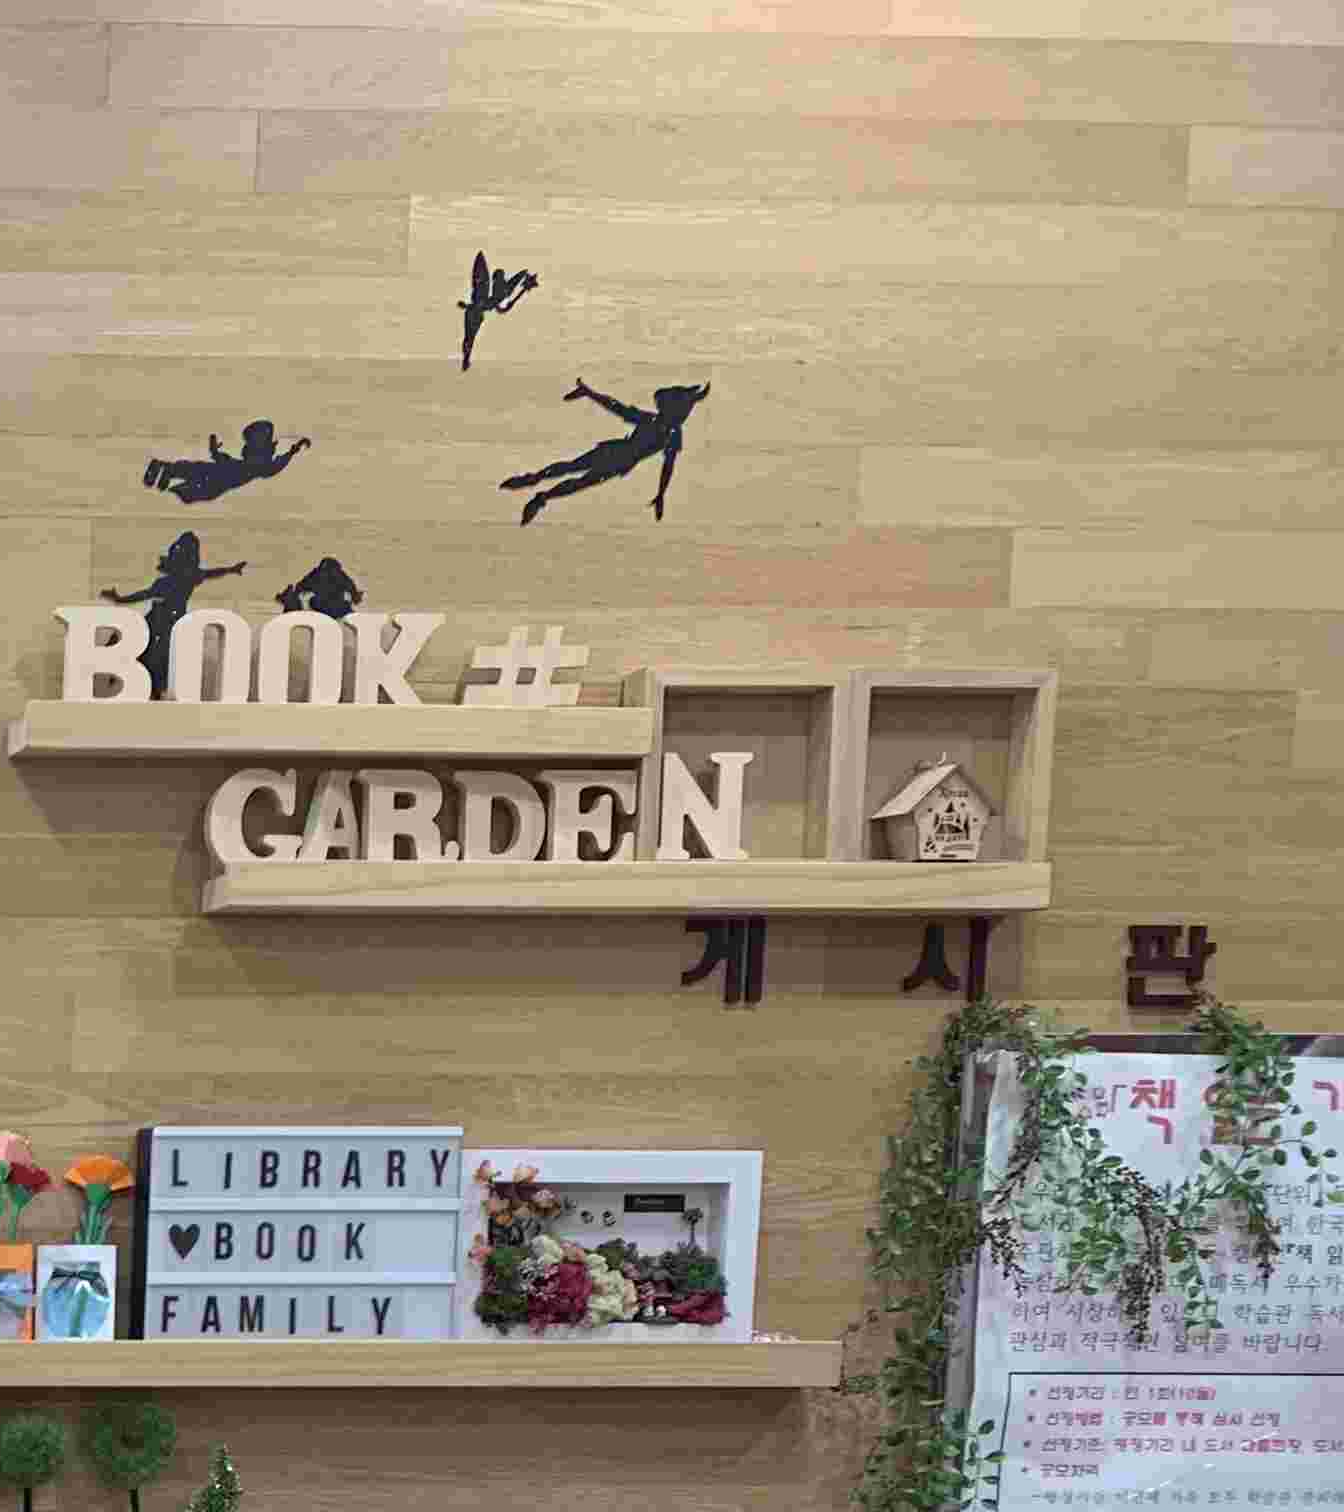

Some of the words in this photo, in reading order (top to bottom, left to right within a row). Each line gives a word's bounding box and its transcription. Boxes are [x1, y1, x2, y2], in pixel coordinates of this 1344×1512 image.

[52, 605, 447, 706] BOOK
[205, 751, 755, 864] GARDEN
[170, 1148, 451, 1189] LIBRARY
[213, 1221, 366, 1262] BOOK
[160, 1295, 393, 1335] FAMILY
